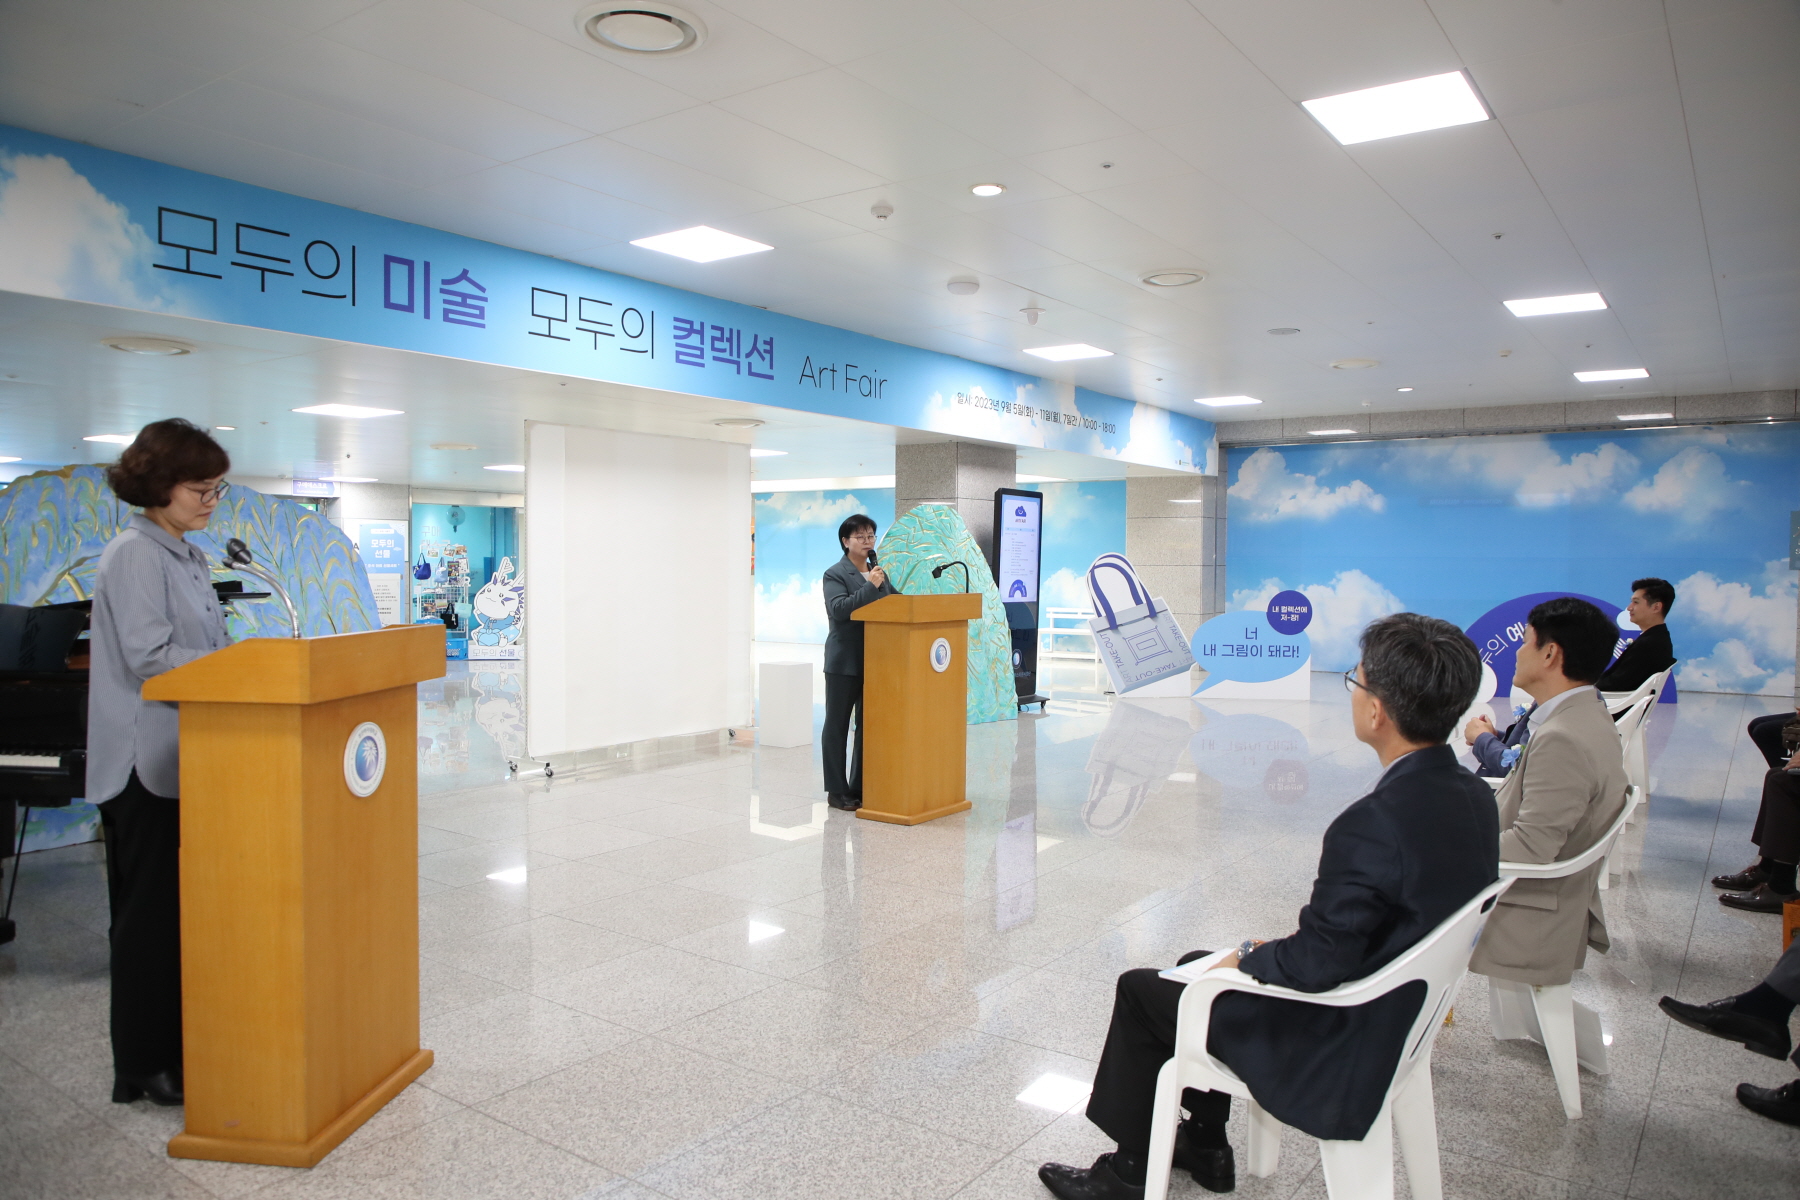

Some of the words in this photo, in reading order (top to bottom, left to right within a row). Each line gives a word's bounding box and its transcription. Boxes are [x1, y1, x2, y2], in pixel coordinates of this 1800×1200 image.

[152, 206, 356, 307] 모두의
[383, 253, 489, 330] 미술
[528, 287, 655, 360] 모두의
[673, 316, 775, 382] 컬렉션
[799, 355, 838, 391] Art
[845, 363, 888, 400] Fair
[974, 395, 1000, 412] 2023년
[1000, 400, 1012, 414] 9월
[1013, 403, 1035, 418] 5일(화)
[1063, 413, 1078, 427] 7일간
[1083, 417, 1098, 431] 10:00
[1102, 422, 1116, 434] 18:00
[371, 539, 395, 548] 모두의
[1272, 605, 1280, 613] 내
[1169, 625, 1192, 656] TAKE-OUT
[1245, 627, 1258, 641] 너
[473, 648, 497, 657] 모두의
[1100, 633, 1125, 669] TAKE-OUT
[1203, 643, 1217, 657] 내
[1221, 644, 1263, 659] 그림이
[1267, 645, 1300, 659] 돼라!
[1135, 662, 1177, 681] TAKE-OUT
